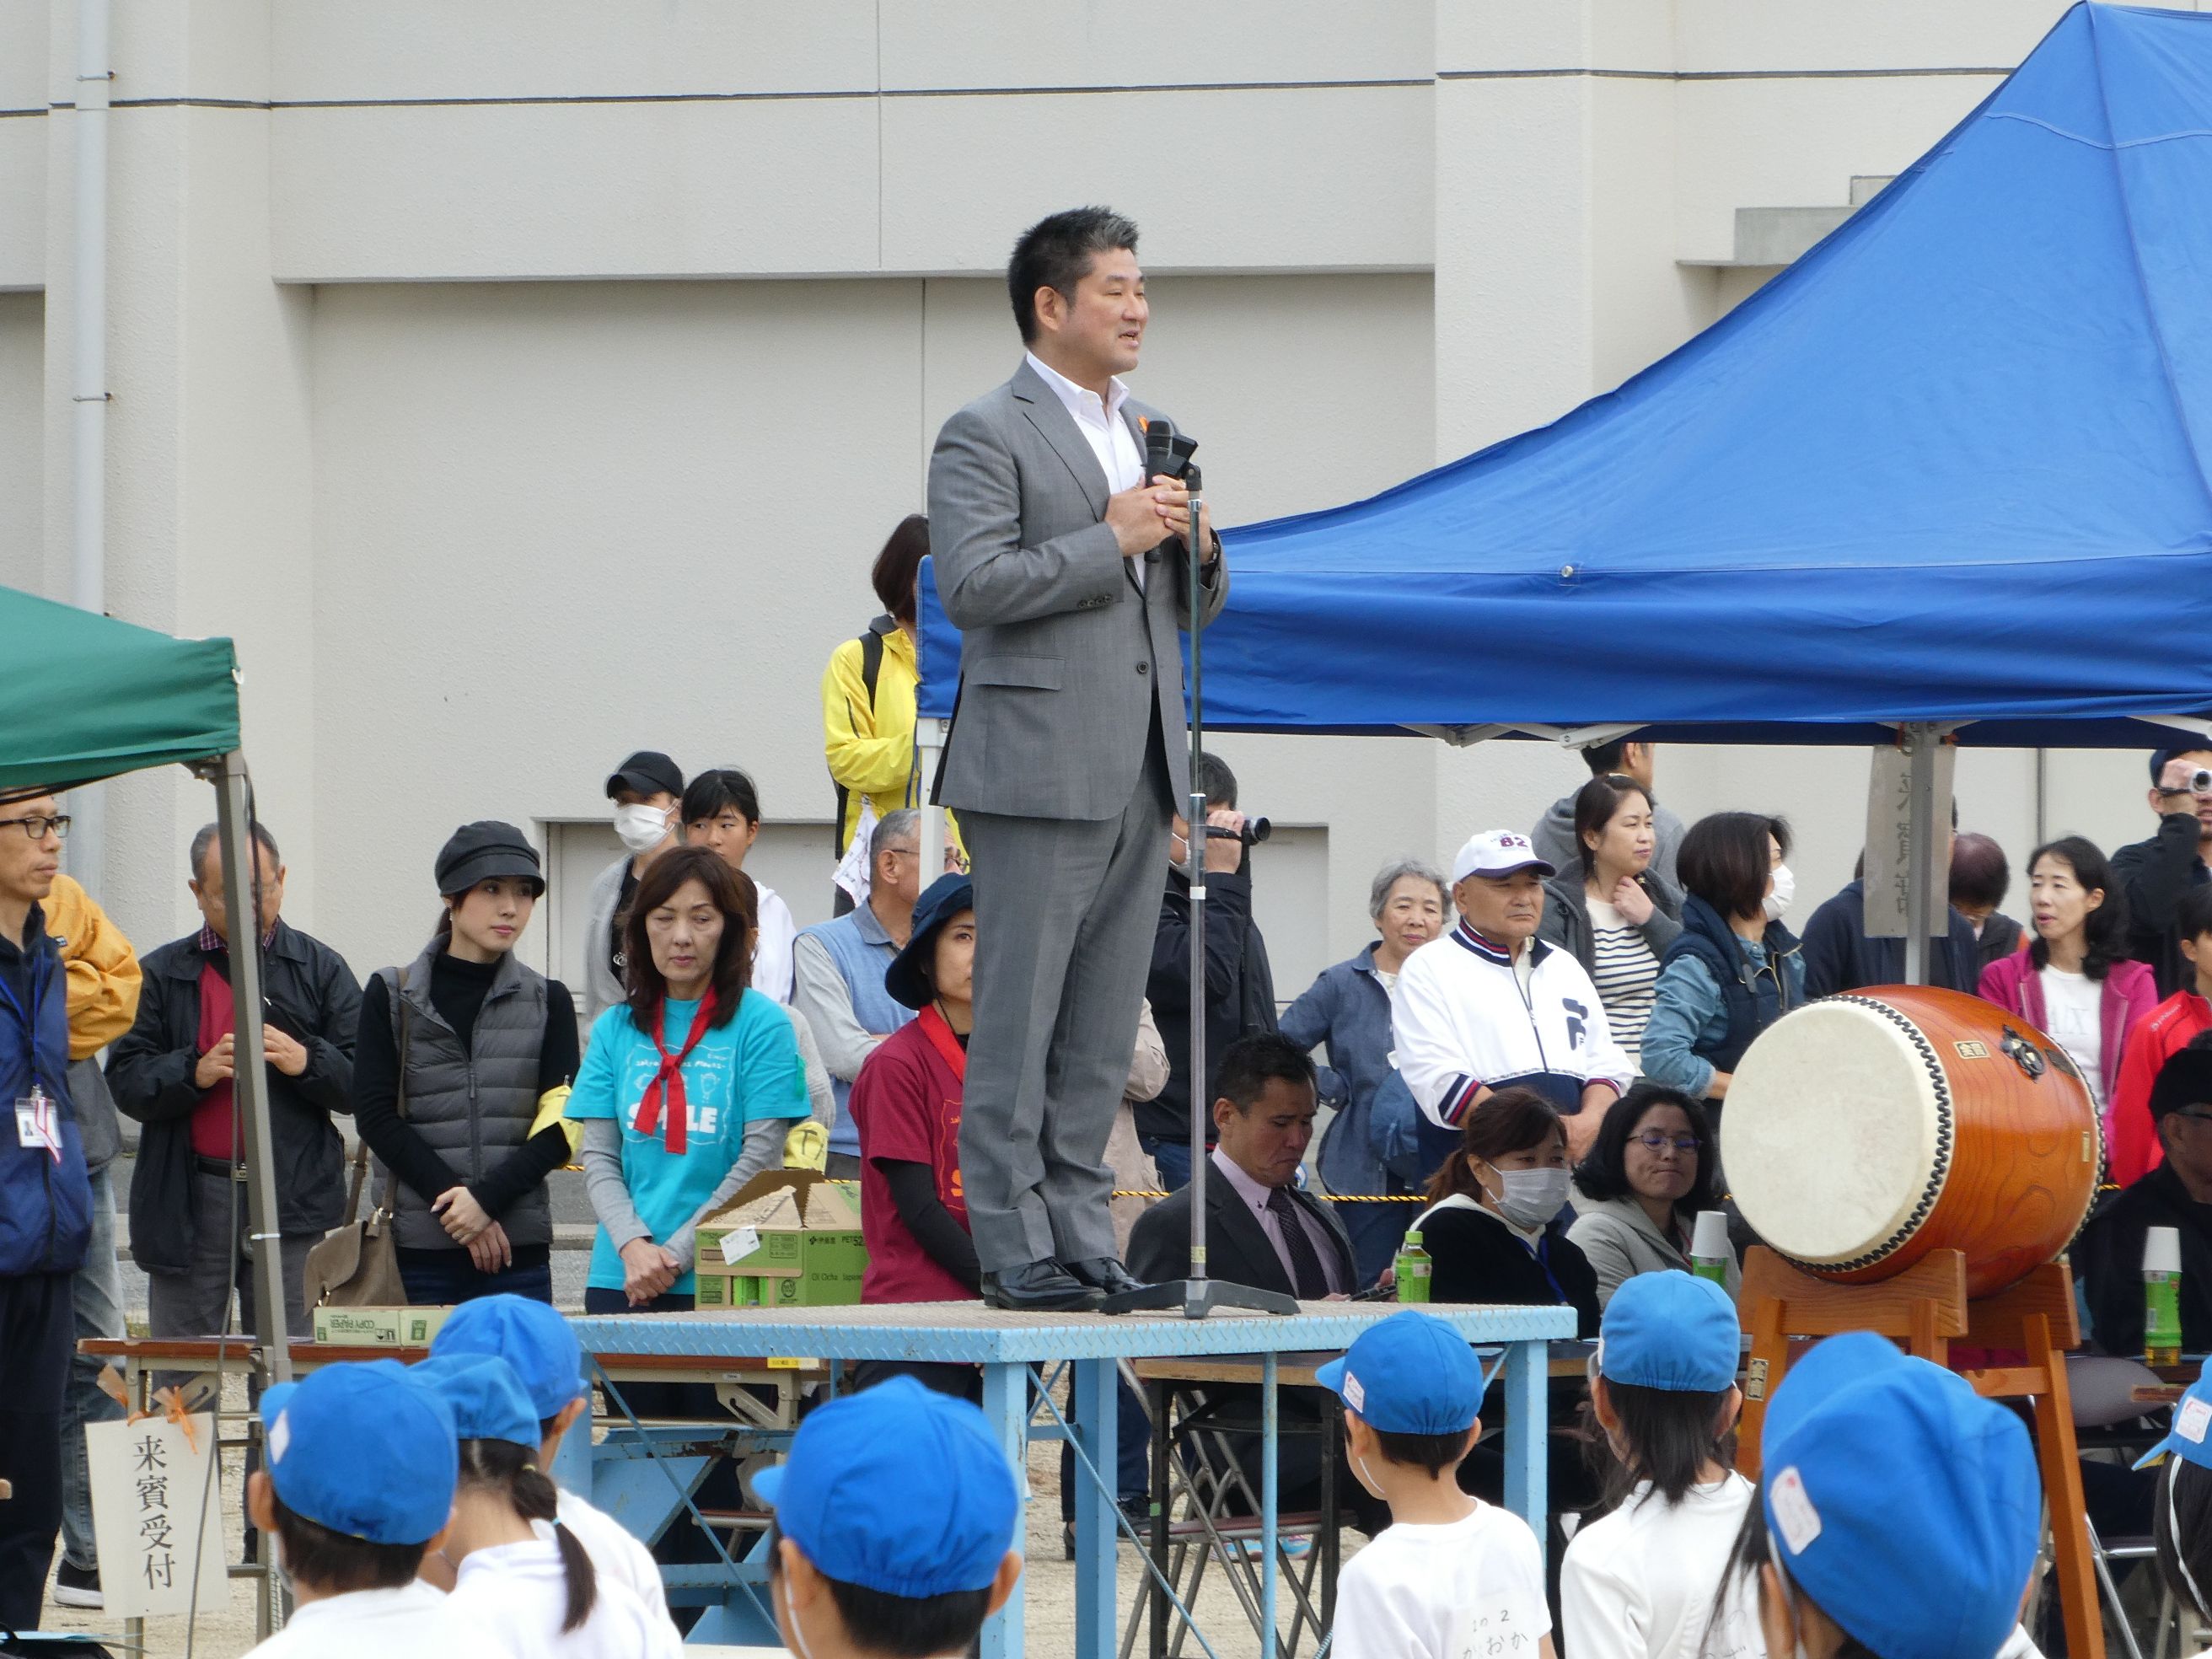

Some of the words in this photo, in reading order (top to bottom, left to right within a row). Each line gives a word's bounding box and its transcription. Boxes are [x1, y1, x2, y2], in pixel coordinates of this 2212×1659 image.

[1500, 836, 1528, 848] 82
[626, 1102, 717, 1134] SLE
[330, 1318, 354, 1329] PAPER
[355, 1319, 375, 1329] COPY
[132, 1434, 176, 1591] 来賓受付
